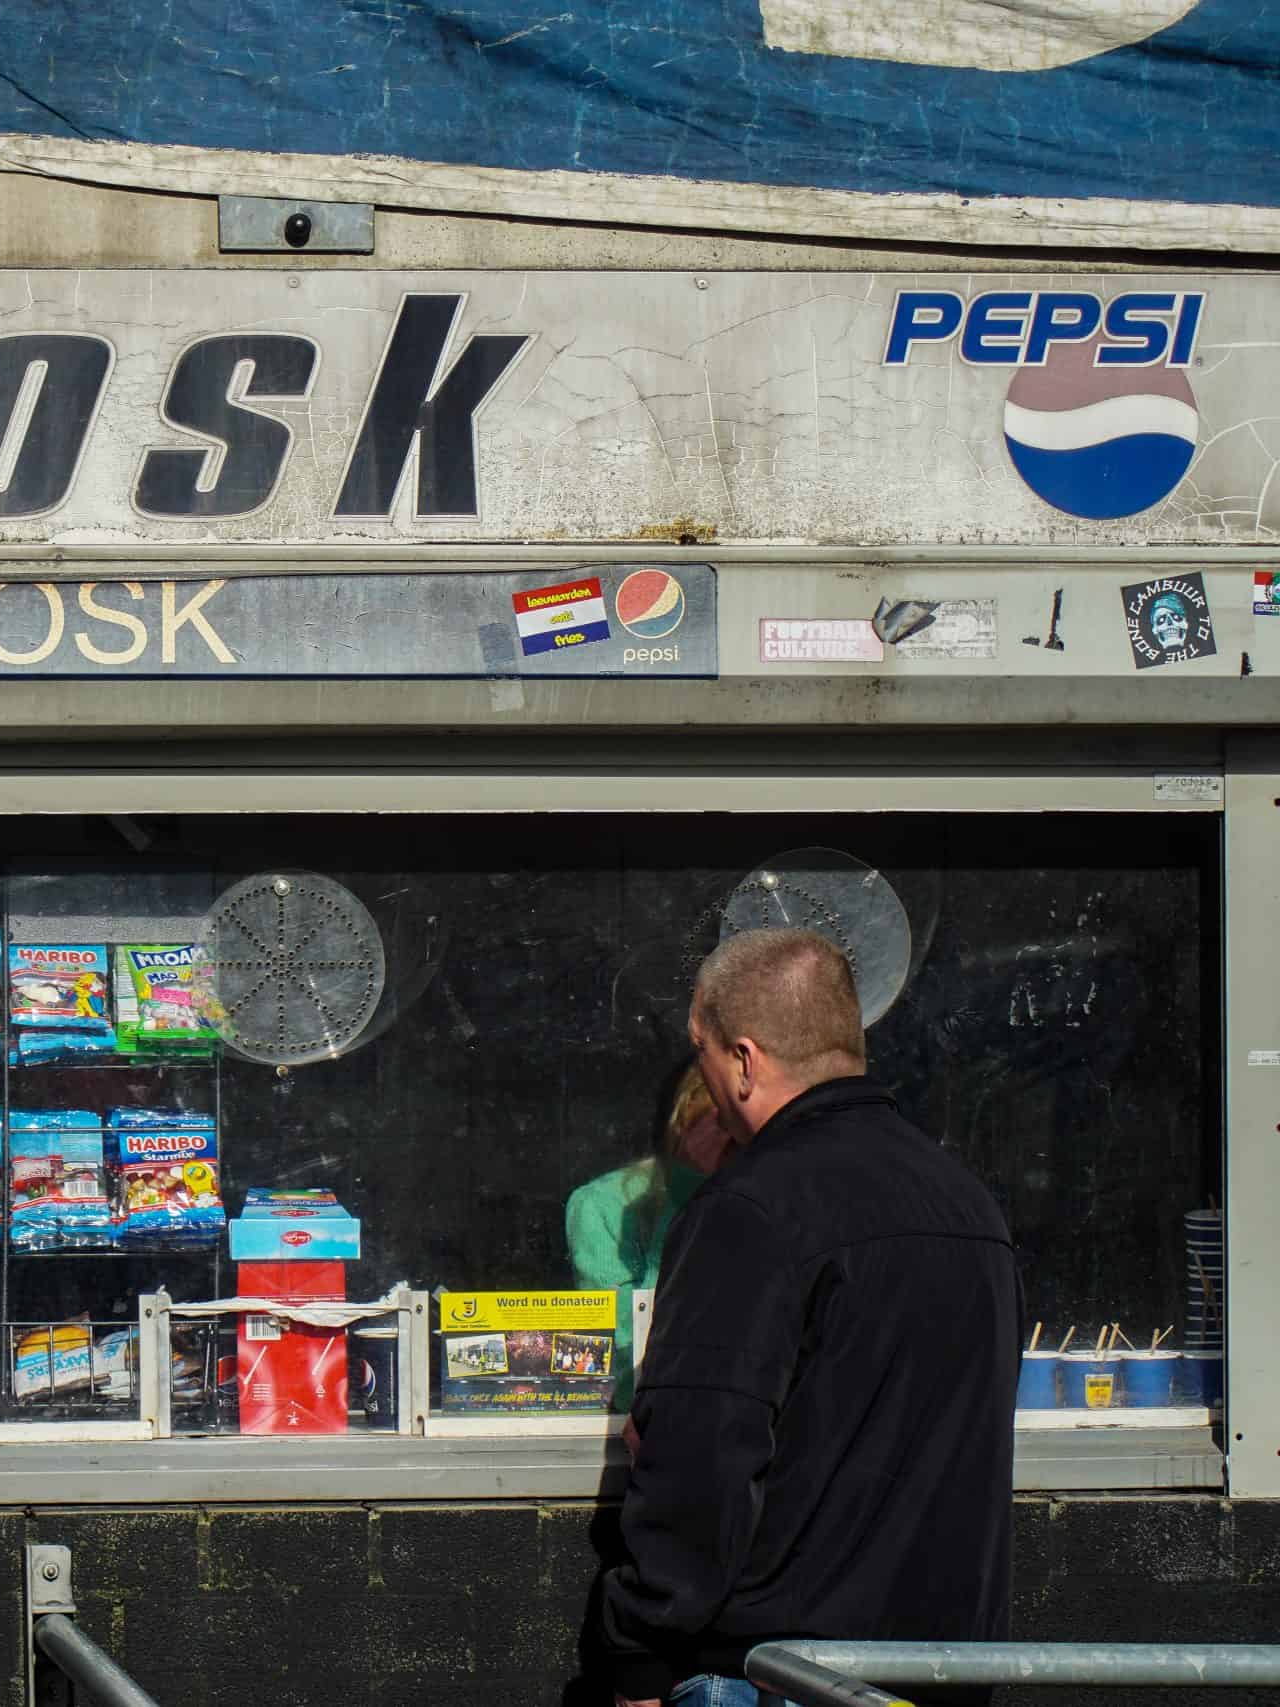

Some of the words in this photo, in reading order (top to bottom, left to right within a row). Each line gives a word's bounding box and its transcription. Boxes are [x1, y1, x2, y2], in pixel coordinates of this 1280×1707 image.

[880, 291, 1207, 368] PEPSI
[1129, 580, 1206, 615] CAMBUUR
[1197, 615, 1210, 641] TO
[554, 632, 586, 647] fries
[1128, 617, 1160, 660] BONE
[623, 645, 678, 664] pepsi
[1165, 643, 1199, 665] THE
[18, 949, 97, 964] HARIBO
[127, 1136, 207, 1152] HARIBO
[142, 1150, 192, 1161] Starmix
[496, 1296, 528, 1308] Word
[532, 1298, 547, 1307] nu
[551, 1296, 609, 1307] donateur!
